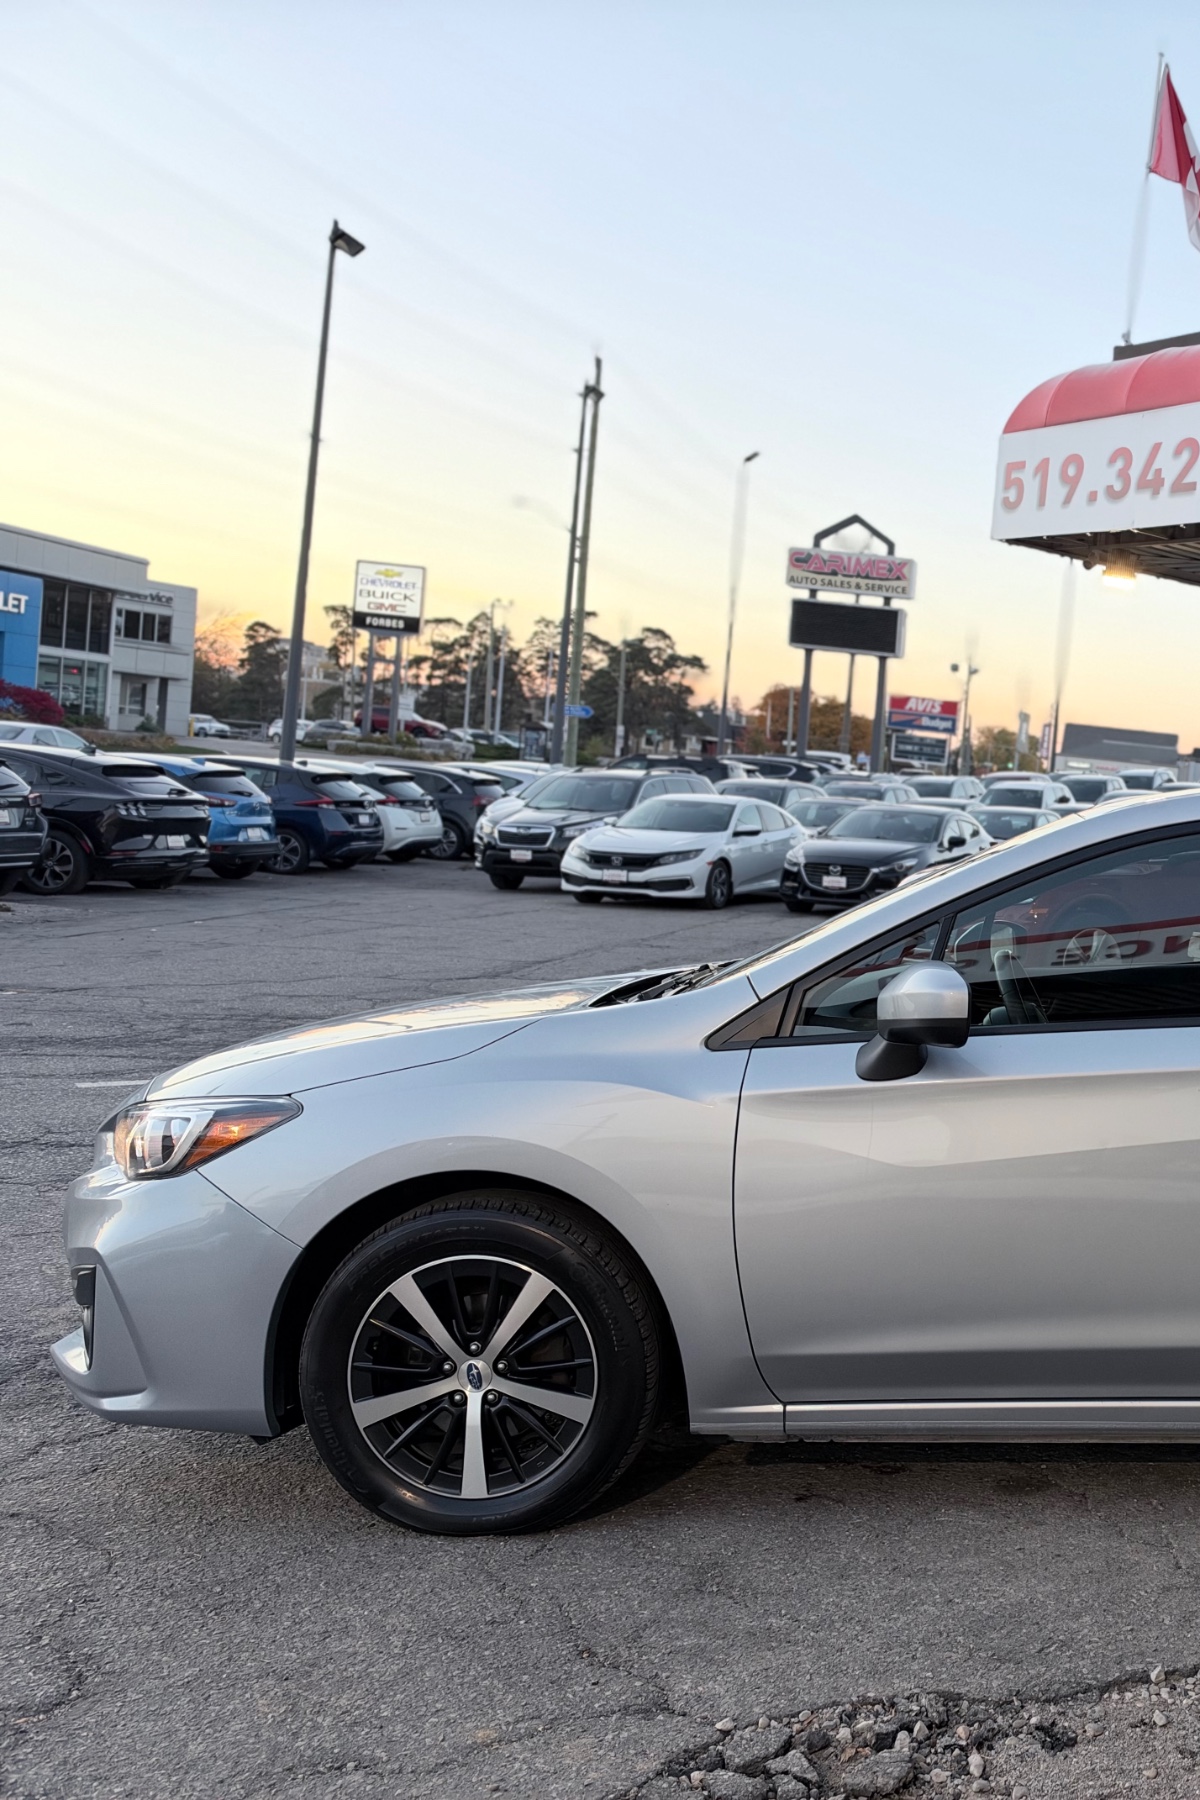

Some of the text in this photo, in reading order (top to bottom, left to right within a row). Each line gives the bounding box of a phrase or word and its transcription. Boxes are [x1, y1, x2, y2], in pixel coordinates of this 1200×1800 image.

[788, 551, 908, 580] CARIMEX
[360, 577, 416, 590] CHEVROLET
[789, 575, 908, 595] AUTO SALES & SERVICE
[359, 588, 416, 603] BUICK
[367, 601, 407, 614] GMC
[365, 616, 405, 629] FORBES
[904, 697, 944, 714] AVIS
[921, 716, 953, 730] Budget
